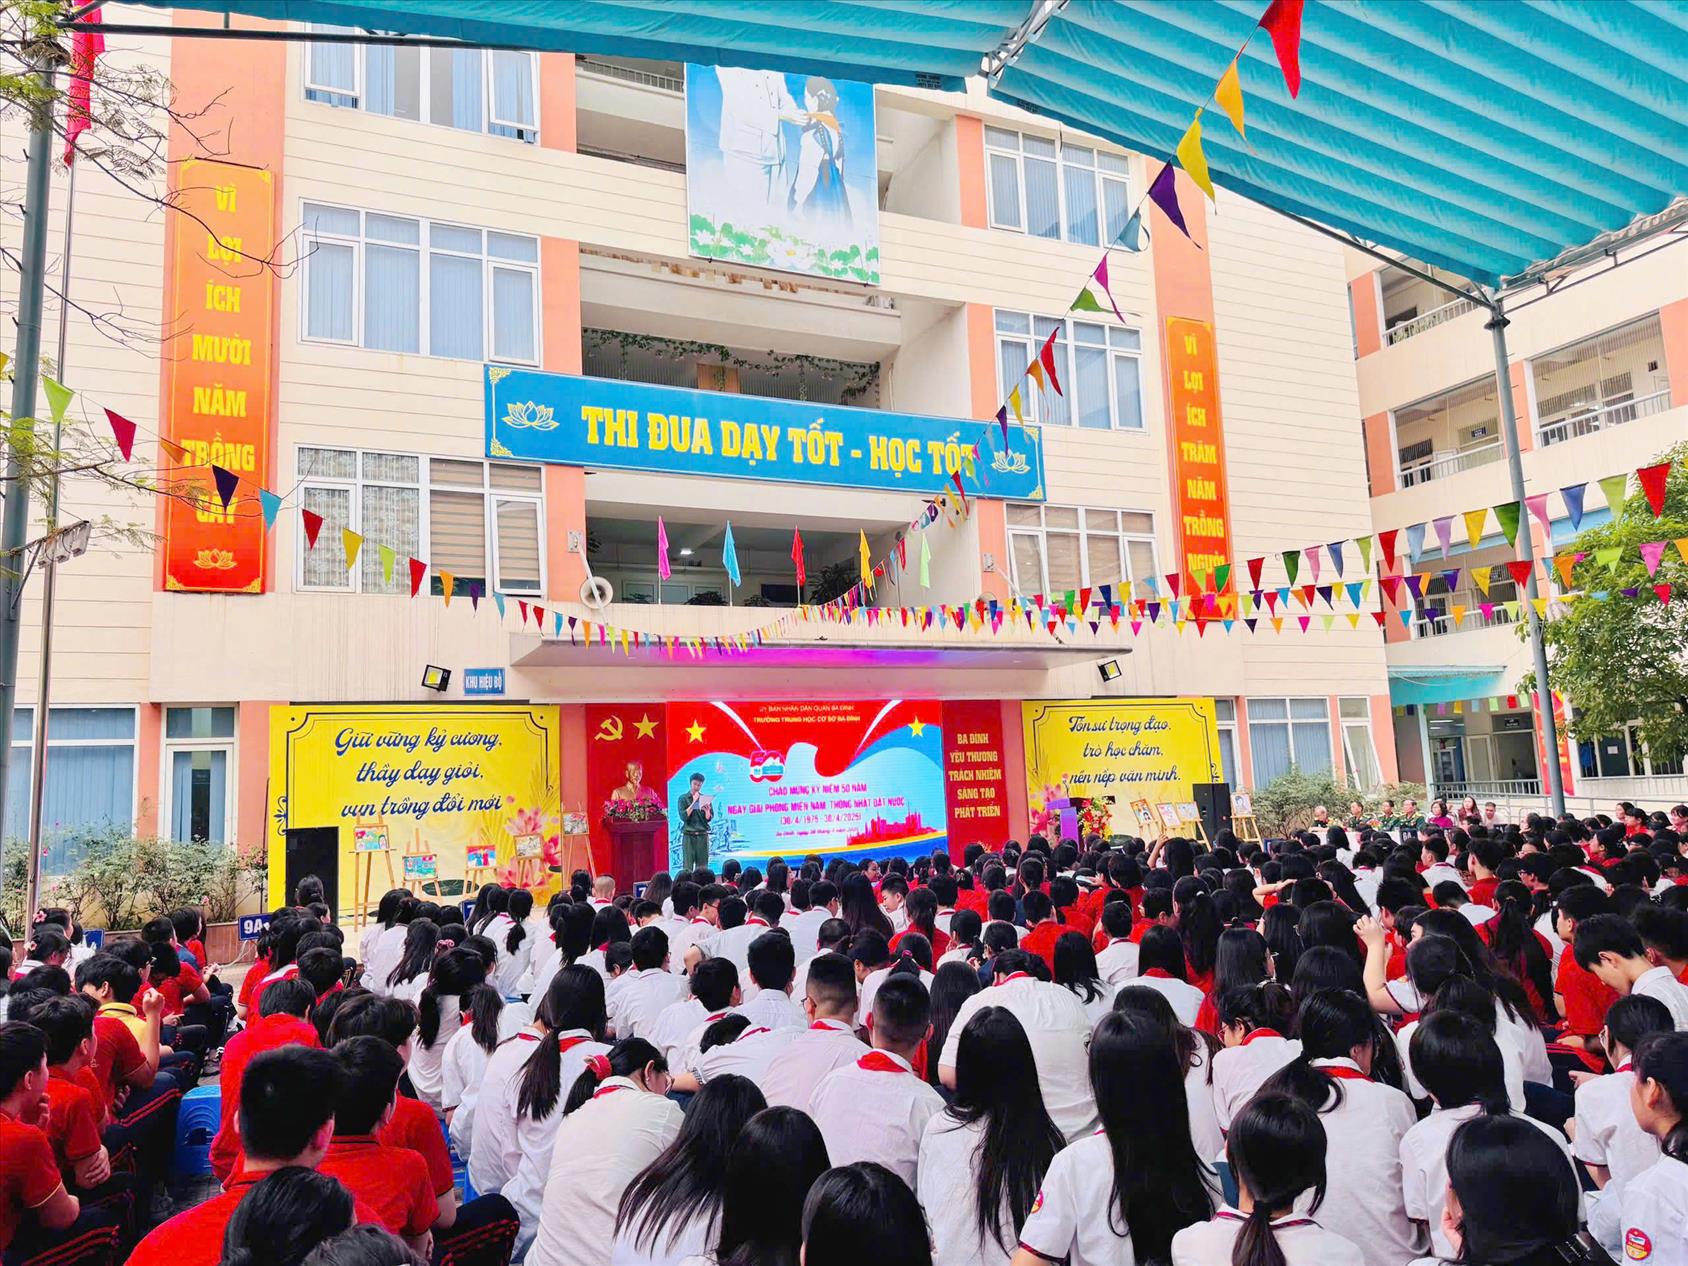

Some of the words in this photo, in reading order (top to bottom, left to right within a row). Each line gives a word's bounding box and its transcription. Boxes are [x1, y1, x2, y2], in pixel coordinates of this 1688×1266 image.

[215, 183, 238, 213] VÌ
[207, 234, 242, 266] LỢI
[204, 280, 241, 313] ÍCH
[192, 333, 251, 366] MƯỜI
[1184, 333, 1197, 356] VÌ
[1183, 370, 1204, 393] LỢI
[192, 383, 247, 418] NĂM
[1186, 402, 1207, 427] ÍCH
[180, 431, 255, 471] TRỒNG
[582, 405, 639, 448] THI
[647, 411, 712, 454] ĐUA
[721, 418, 779, 466] DẠY
[787, 417, 844, 466] TỐT
[869, 435, 922, 478] HỌC
[1181, 440, 1217, 464] TRĂM
[1187, 476, 1217, 501] NĂM
[1183, 510, 1224, 538] TRỒNG
[465, 675, 478, 689] KHU
[1068, 715, 1091, 732] Tôn
[1091, 720, 1107, 732] sư
[1109, 716, 1141, 735] trọng
[335, 727, 373, 756] Giữ
[376, 731, 420, 753] vững
[424, 726, 447, 752] kỷ
[957, 733, 968, 744] BA
[969, 731, 989, 744] ĐÌNH
[950, 750, 964, 763] YÊU
[966, 751, 998, 762] THƯƠNG
[1083, 742, 1101, 758] trò
[1105, 741, 1126, 759] học
[356, 761, 400, 787] thầy
[403, 760, 441, 786] dạy
[948, 768, 974, 781] TRÁCH
[975, 767, 1001, 781] NHIỆM
[1094, 768, 1116, 788] nếp
[1120, 770, 1142, 782] văn
[842, 784, 850, 793] 50
[957, 787, 978, 800] SÁNG
[980, 787, 996, 800] TẠO
[341, 804, 376, 818] vun
[380, 795, 429, 820] trồng
[432, 792, 465, 813] đổi
[467, 794, 502, 811] mới
[954, 805, 975, 818] PHÁT
[976, 801, 1000, 817] TRIỂN
